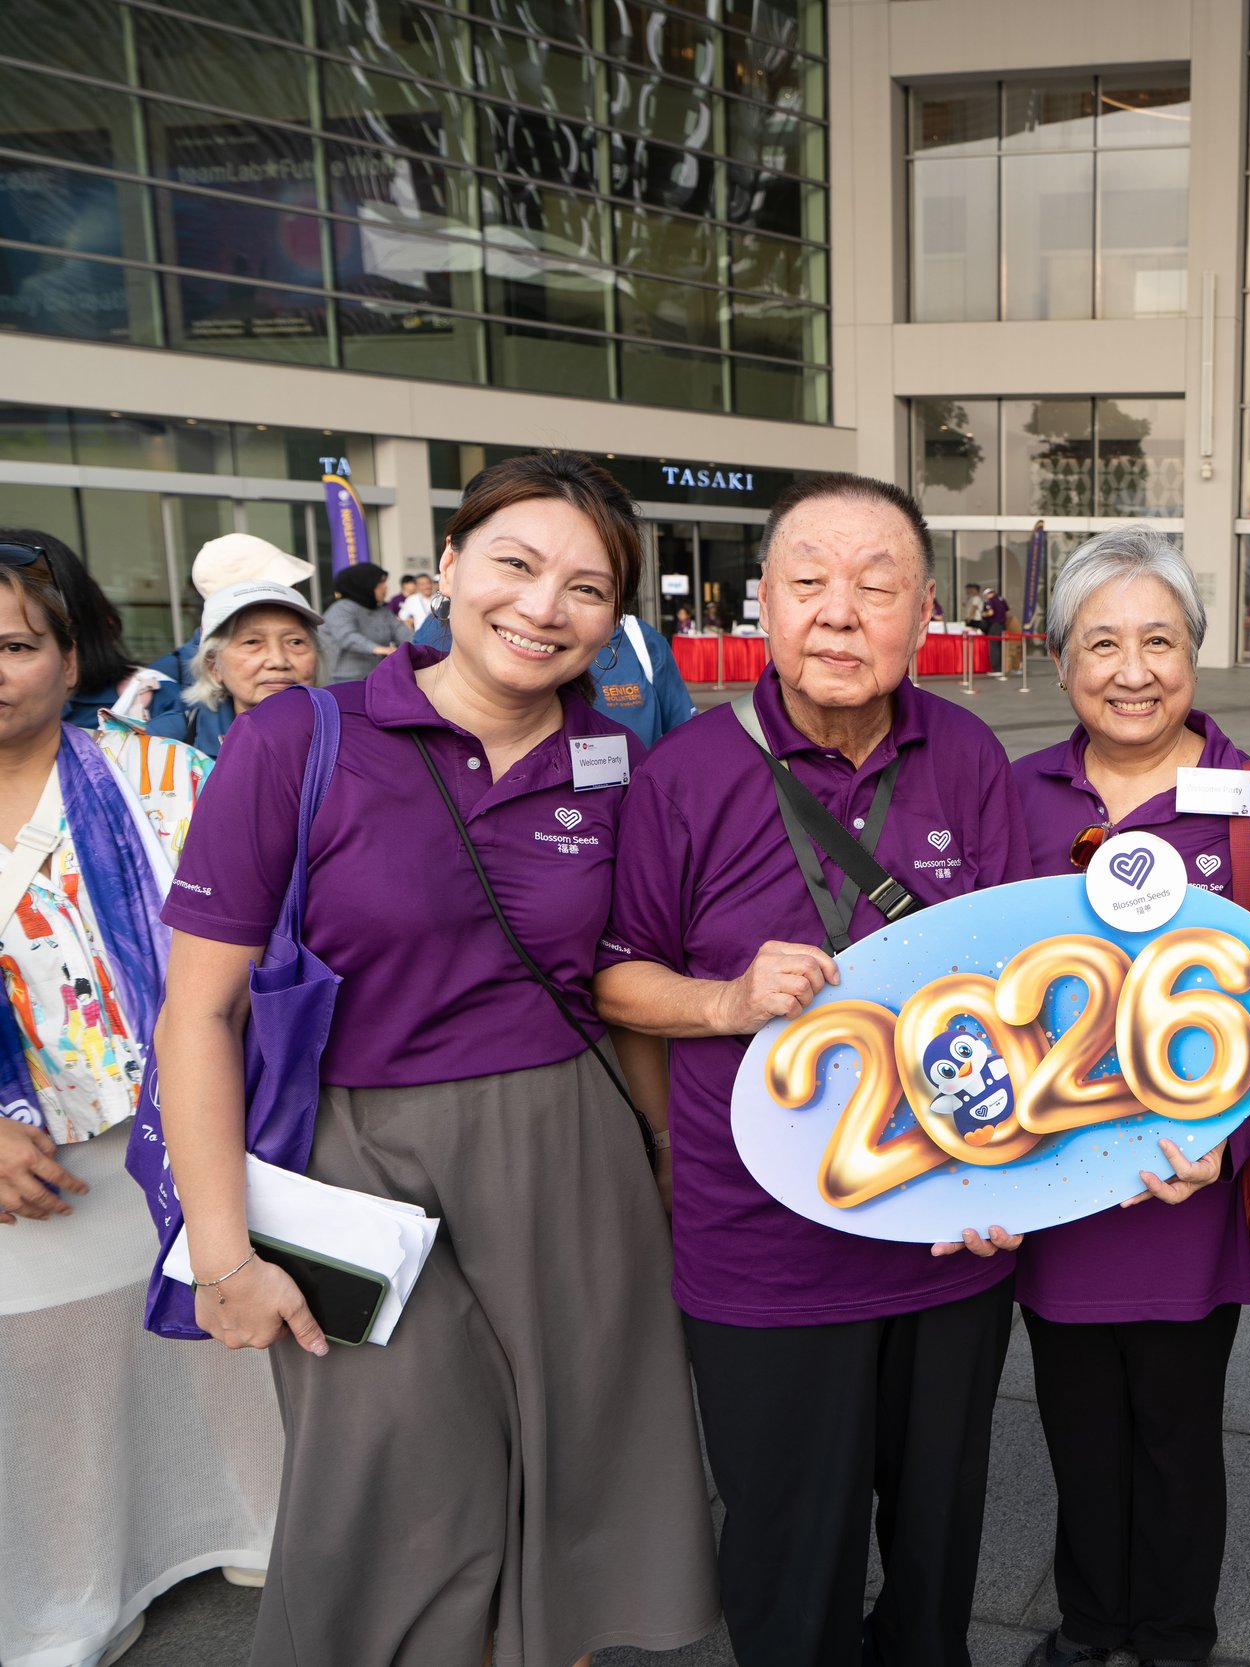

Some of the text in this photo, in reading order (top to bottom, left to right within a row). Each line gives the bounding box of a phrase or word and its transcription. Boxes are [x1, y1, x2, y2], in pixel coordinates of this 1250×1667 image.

[661, 466, 754, 491] TASAKI
[602, 685, 641, 697] SENIOR
[580, 756, 622, 767] Welcome Party
[534, 831, 599, 845] Blossom Seeds
[914, 859, 946, 869] Blossom
[1112, 889, 1171, 911] Blossom Seeds
